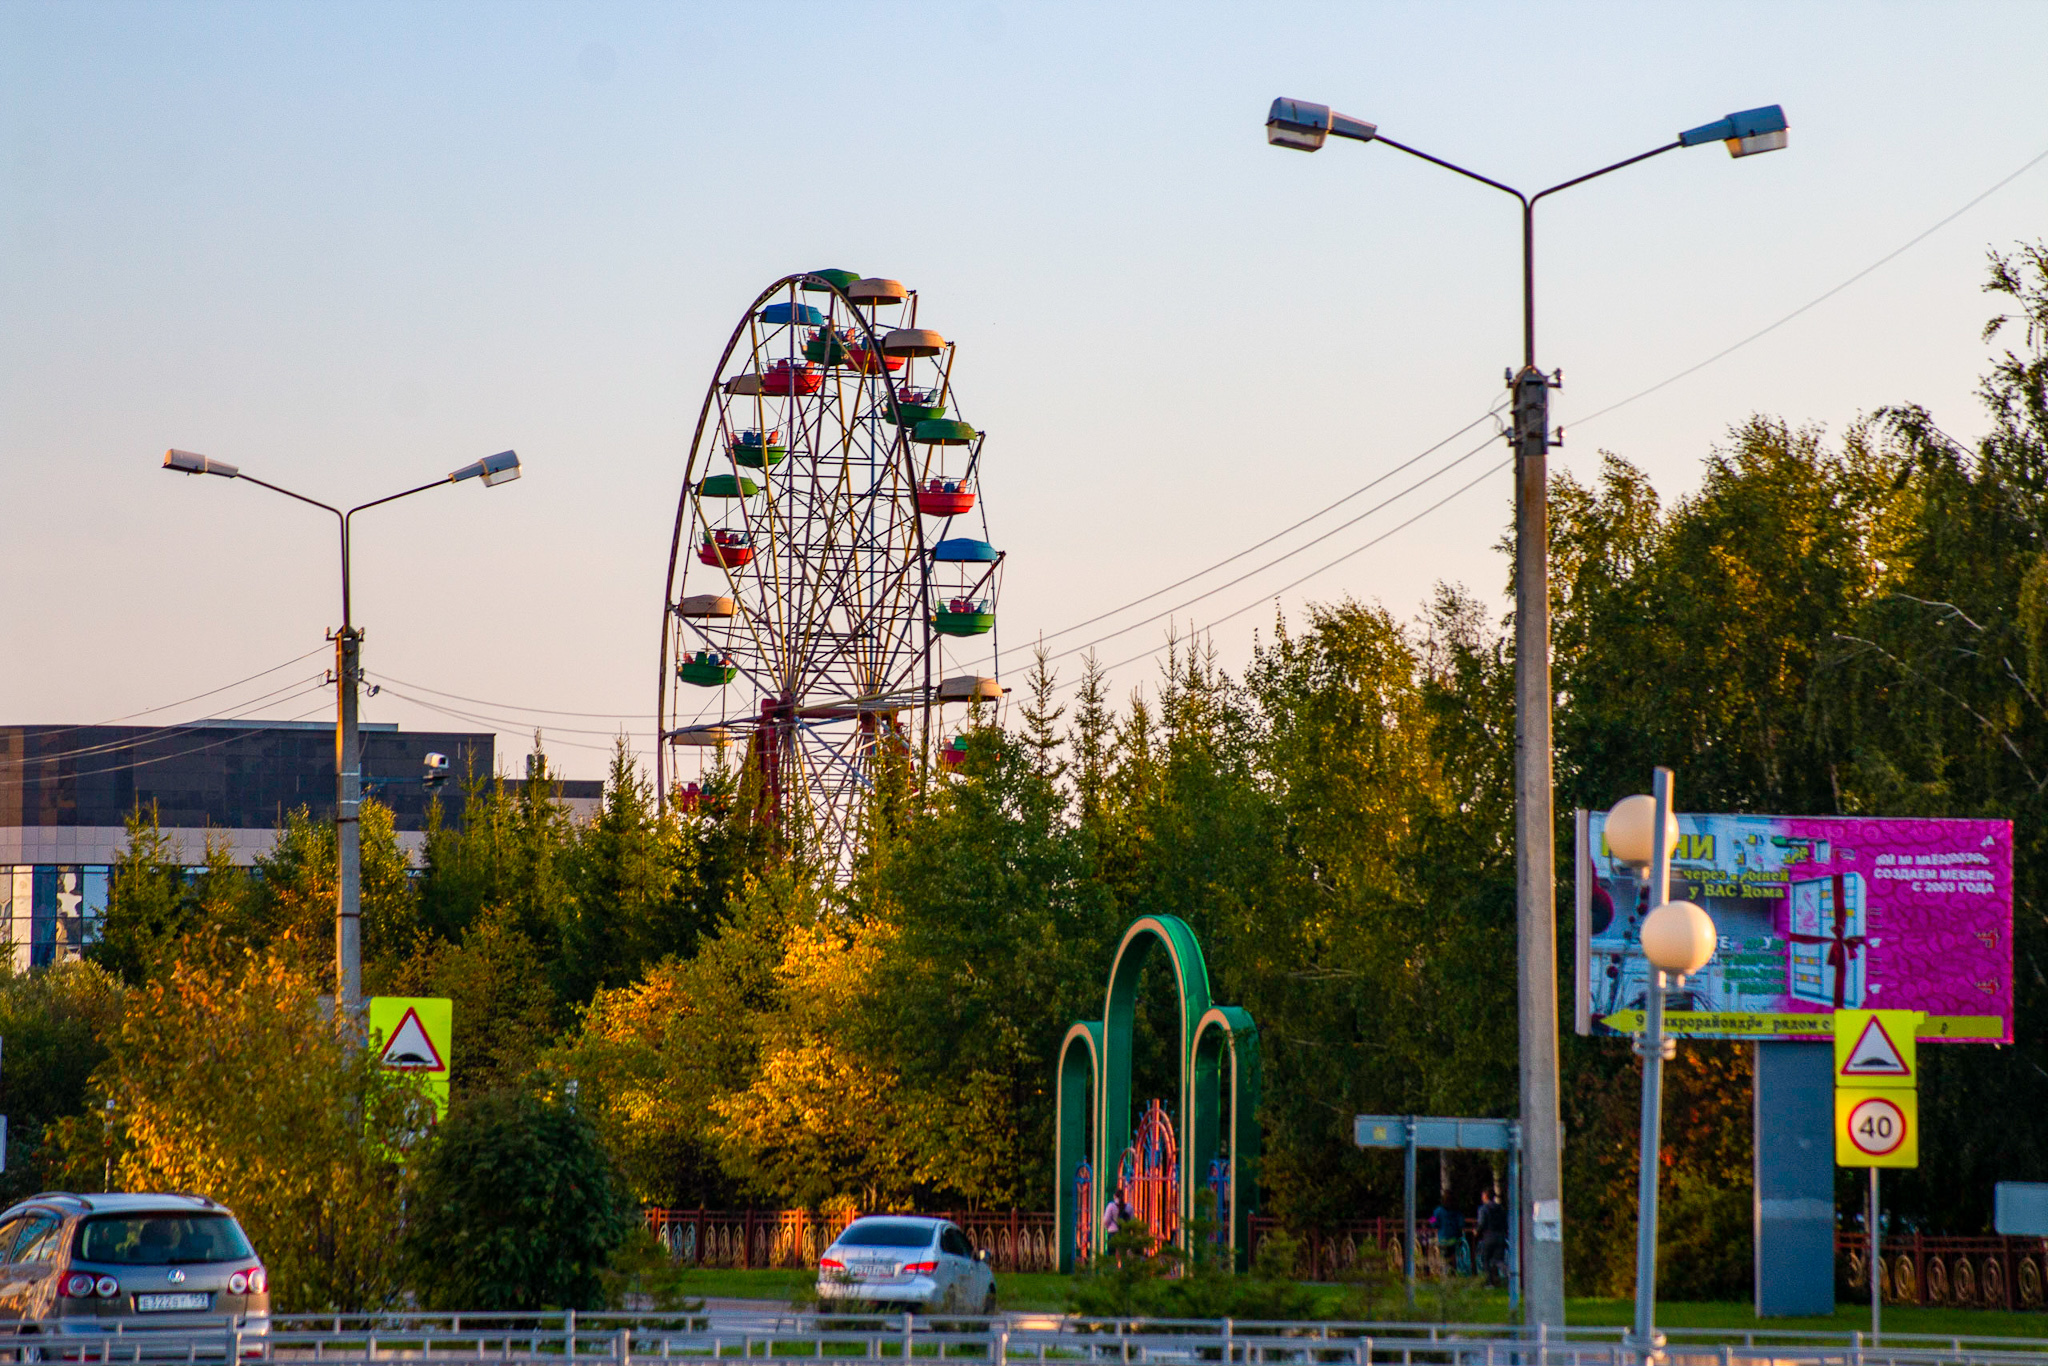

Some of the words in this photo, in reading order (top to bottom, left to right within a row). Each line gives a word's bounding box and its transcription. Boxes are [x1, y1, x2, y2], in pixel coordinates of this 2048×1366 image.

[1683, 870, 1726, 883] через
[1873, 867, 1938, 880] СОЗДАЕМ
[1939, 869, 1995, 880] МЕБЕЛЬ
[1704, 884, 1737, 896] ВАС
[1957, 881, 1995, 896] ГОДА
[1859, 1116, 1892, 1138] 40
